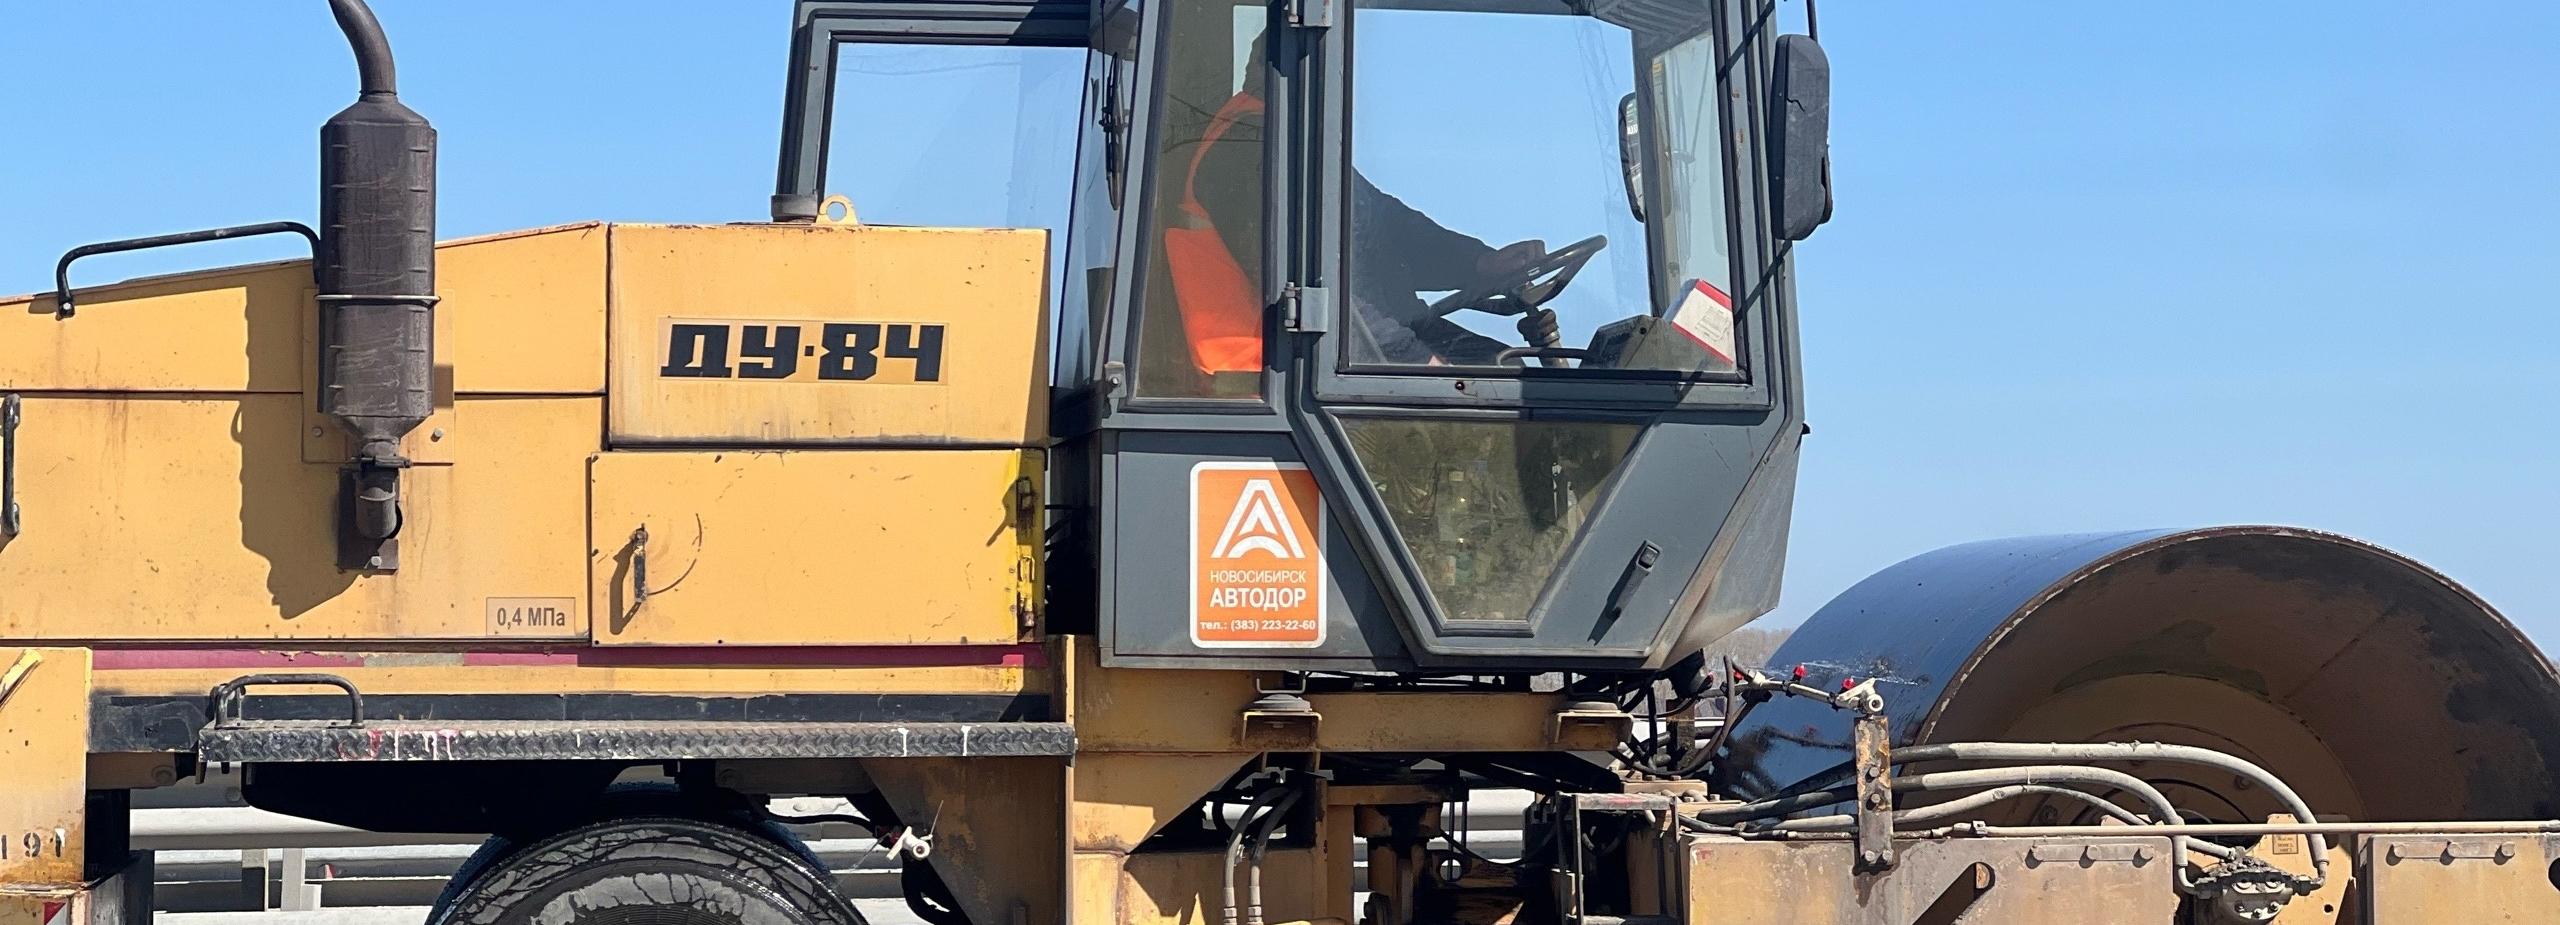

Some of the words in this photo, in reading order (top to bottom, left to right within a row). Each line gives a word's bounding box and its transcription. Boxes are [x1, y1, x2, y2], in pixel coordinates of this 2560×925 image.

[1210, 570, 1306, 583] НОВОСИБИРСК
[1210, 588, 1306, 611] АВТОДОР
[496, 607, 523, 629] 0,4
[527, 607, 566, 627] МПа
[1200, 621, 1227, 631] тел.:
[1230, 620, 1260, 632] (383)
[1261, 620, 1316, 632] 223-22-60
